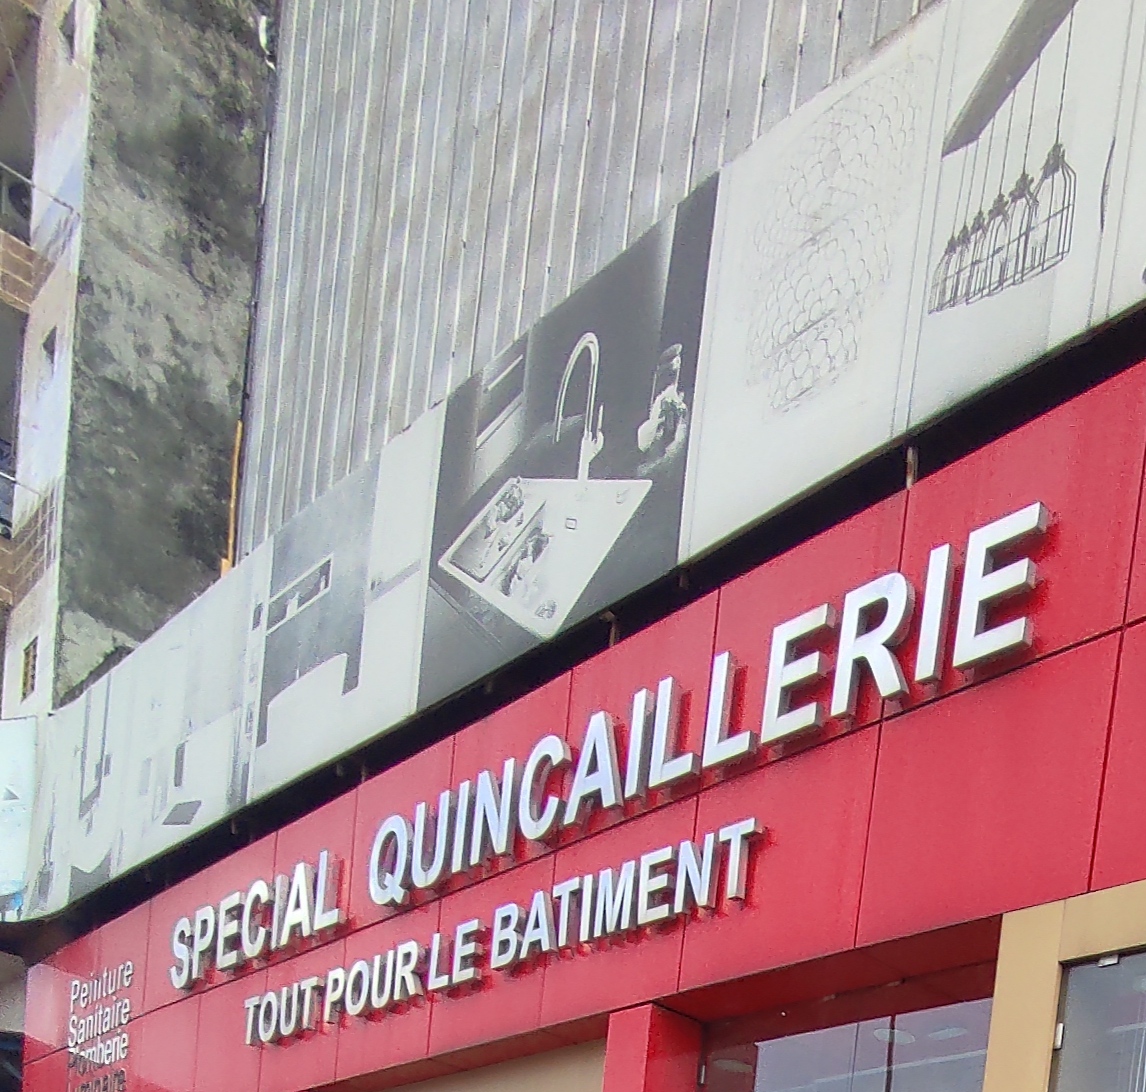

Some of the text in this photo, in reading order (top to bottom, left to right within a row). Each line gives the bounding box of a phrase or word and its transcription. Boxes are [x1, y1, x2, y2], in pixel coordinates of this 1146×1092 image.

[168, 501, 1048, 990] SPECIAL QUINCAILLERIE
[69, 960, 134, 1012] Peinture
[244, 818, 758, 1046] TOUT POUR LE BATIMENT
[68, 996, 132, 1048] Sanitaire
